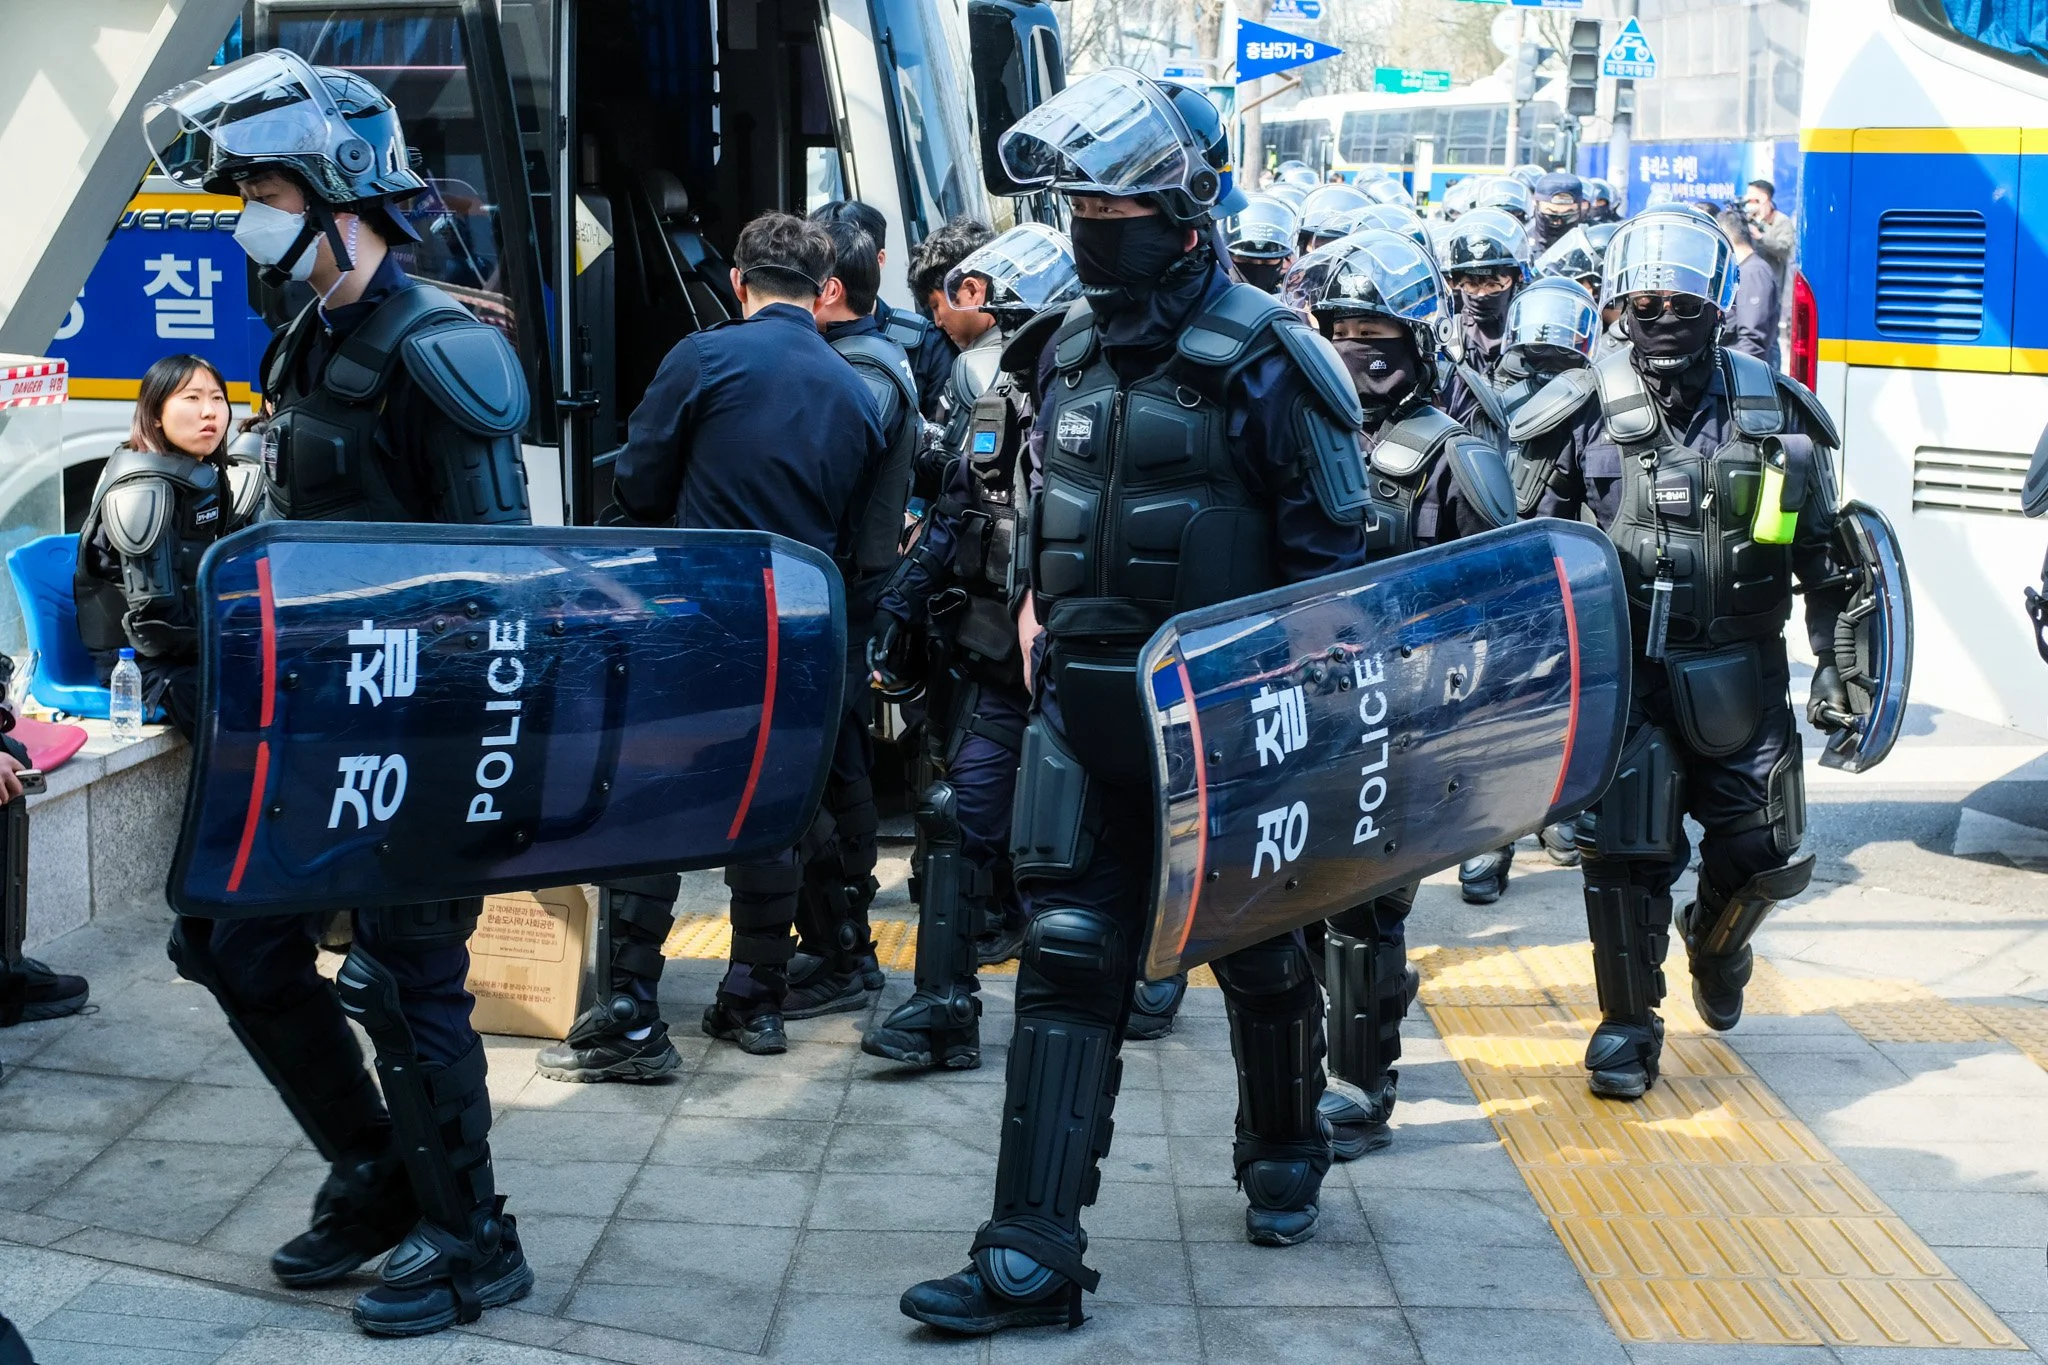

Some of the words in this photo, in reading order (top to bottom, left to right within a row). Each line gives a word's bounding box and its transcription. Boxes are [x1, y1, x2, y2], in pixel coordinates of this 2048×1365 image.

[1246, 42, 1314, 60] 충남5기-3
[12, 380, 43, 395] DANGER
[49, 377, 65, 391] 위험
[1655, 491, 1686, 501] 기-충남41
[327, 619, 418, 830] 경찰
[466, 619, 526, 823] POLICE
[1353, 653, 1389, 846] POLICE
[1251, 686, 1309, 879] 경찰
[524, 918, 554, 930] 사회공헌
